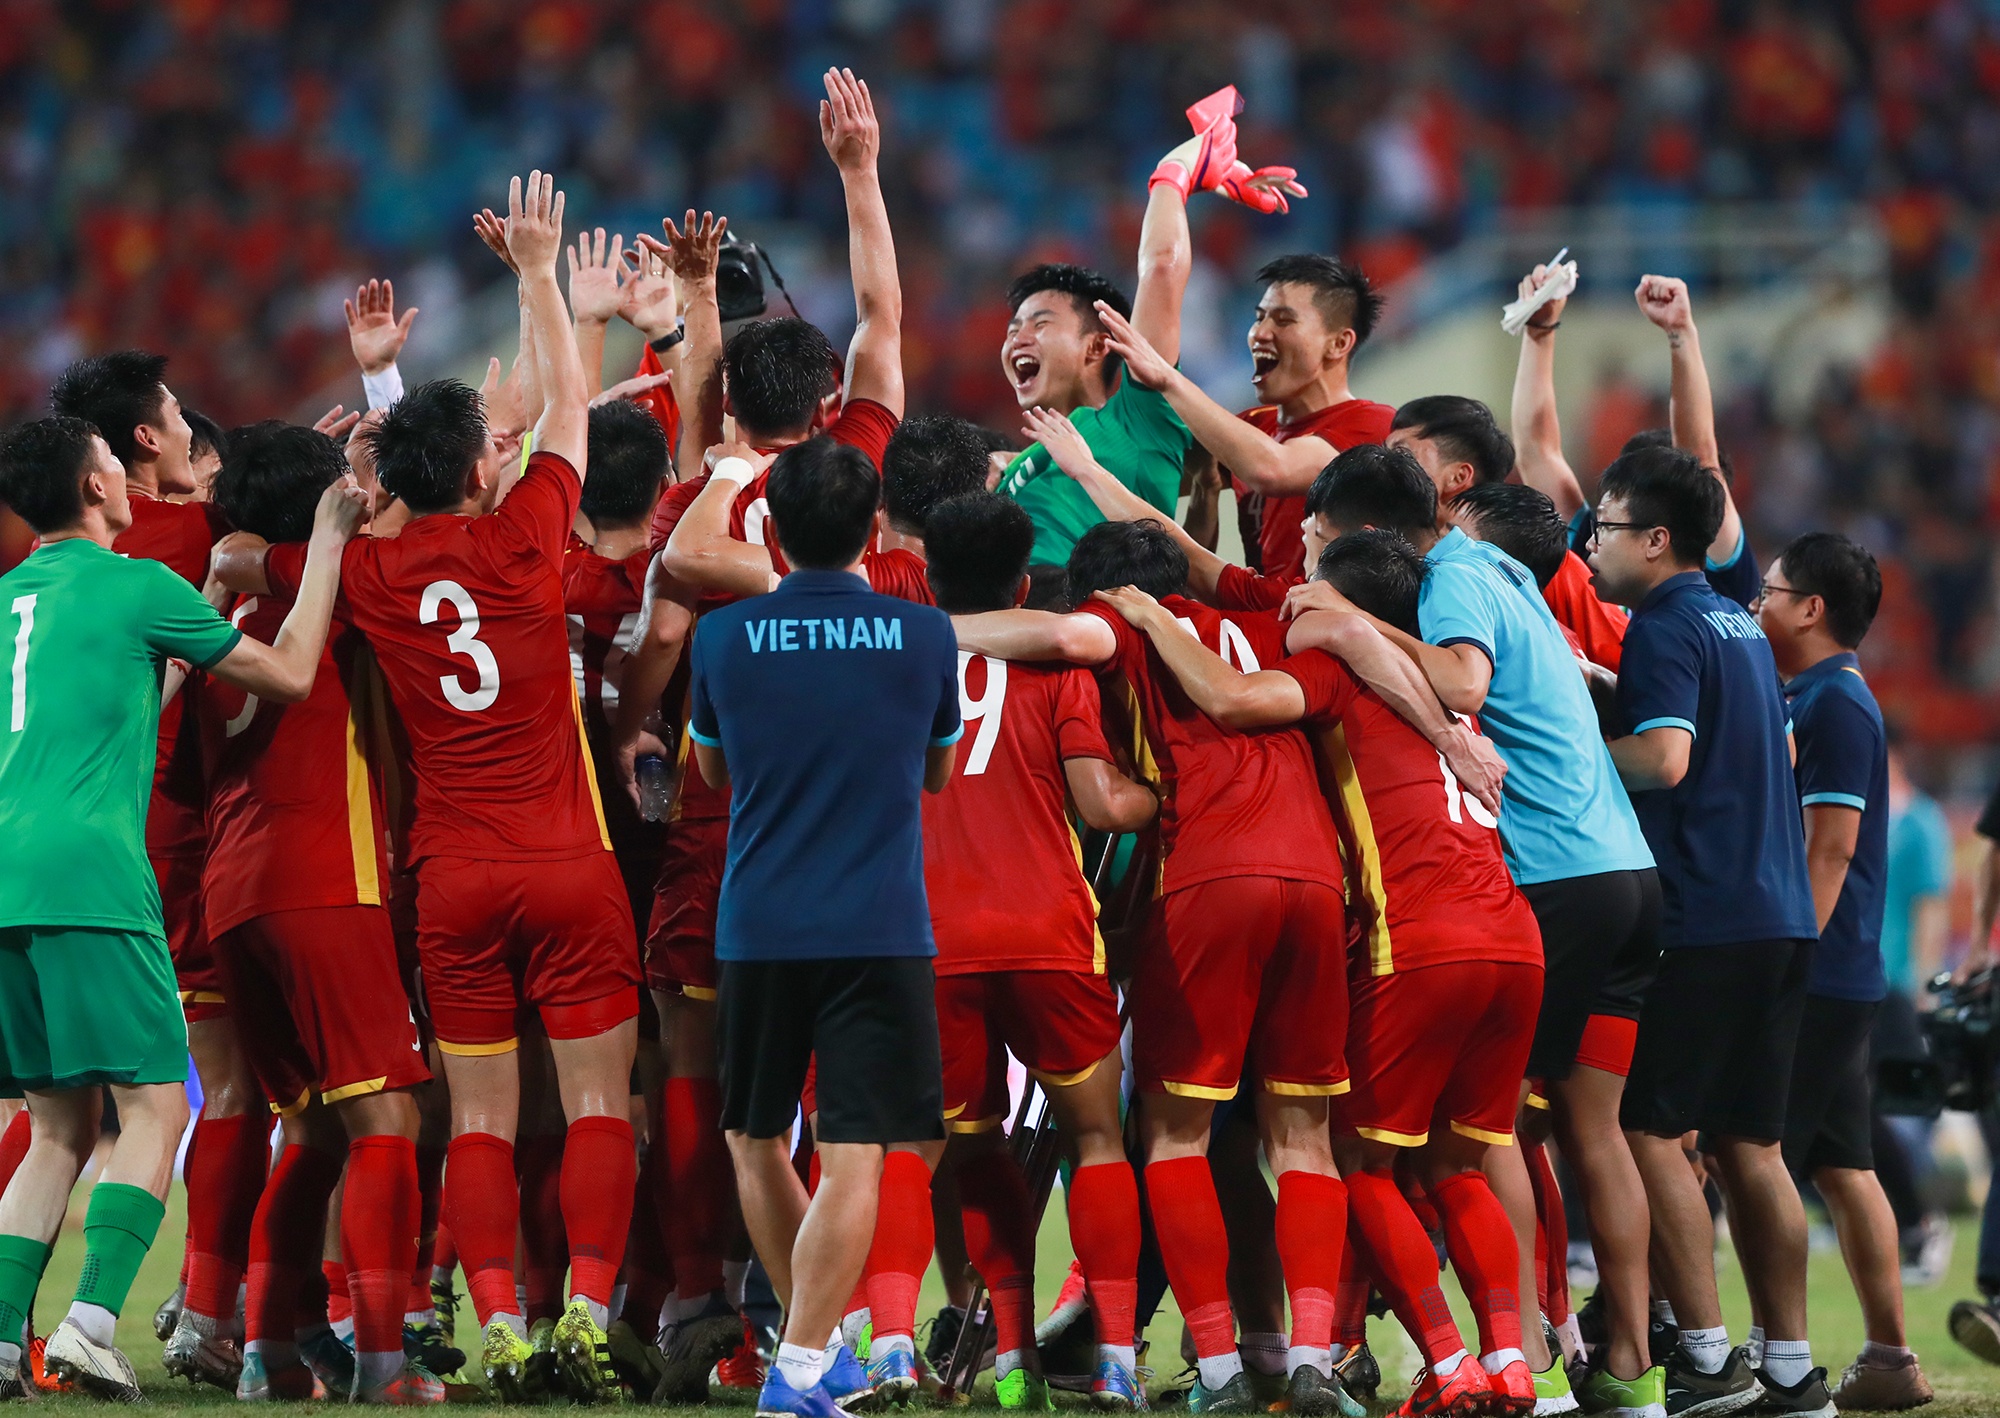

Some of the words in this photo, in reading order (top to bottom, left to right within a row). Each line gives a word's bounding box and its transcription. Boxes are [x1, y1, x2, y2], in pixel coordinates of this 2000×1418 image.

[10, 593, 38, 732] 1
[418, 579, 500, 711] 3
[744, 616, 903, 654] VIETNAM
[1702, 610, 1767, 639] VIETNA
[957, 649, 1008, 776] 9
